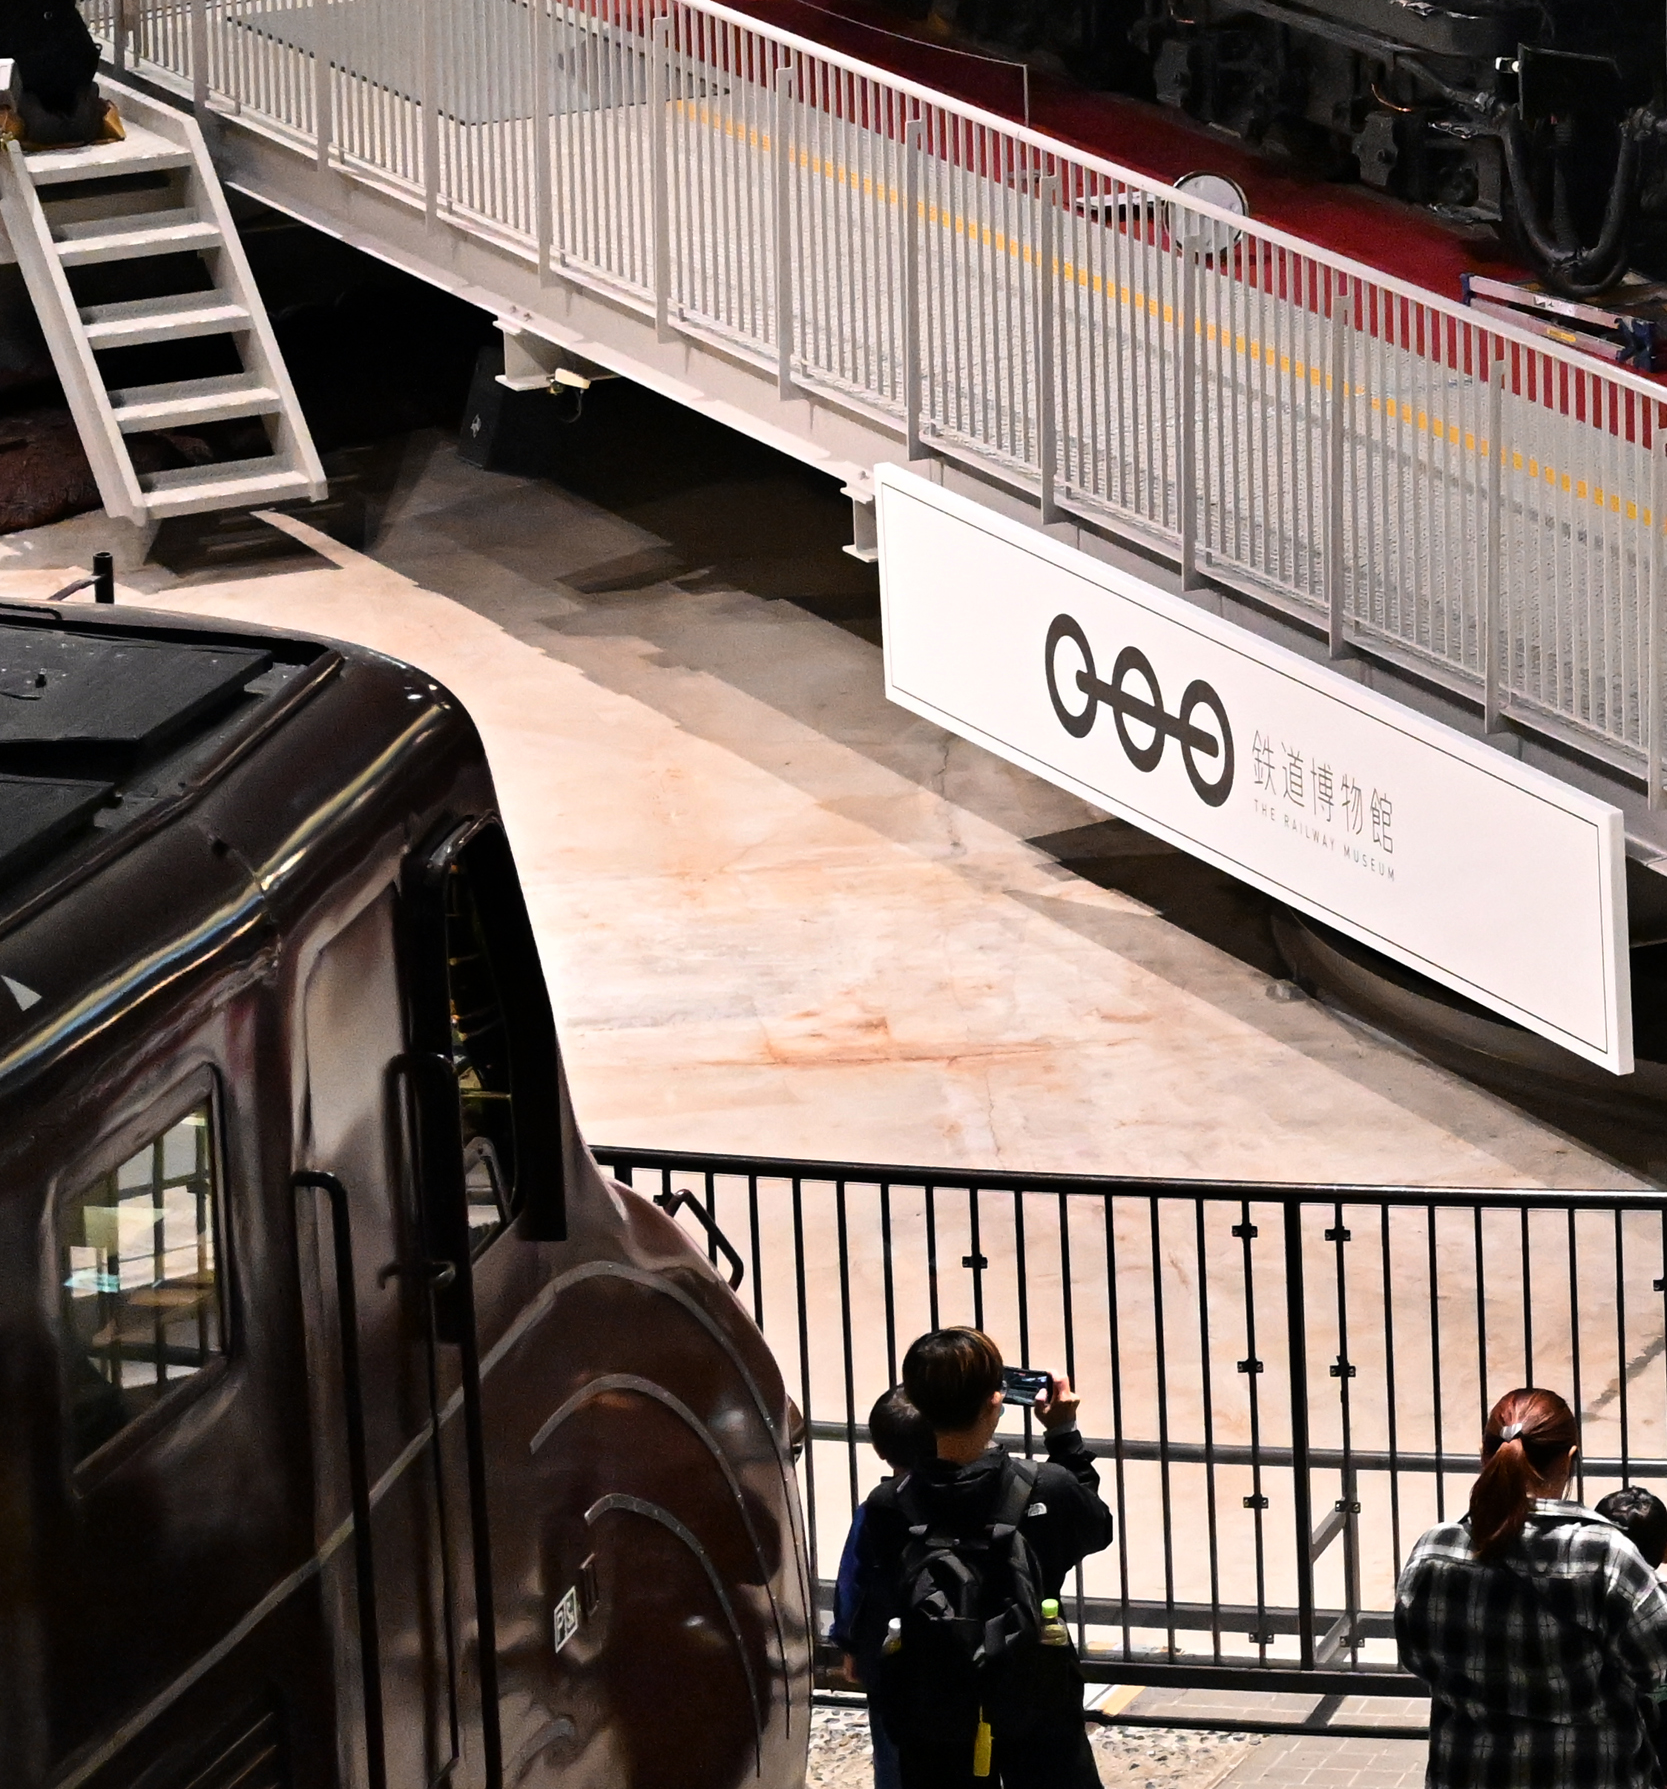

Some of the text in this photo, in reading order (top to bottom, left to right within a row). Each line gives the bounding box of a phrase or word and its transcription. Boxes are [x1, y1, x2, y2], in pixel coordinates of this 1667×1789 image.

[1252, 730, 1394, 854] 鉄道博物館
[1254, 798, 1395, 882] THE RAILWAY MUSEUM
